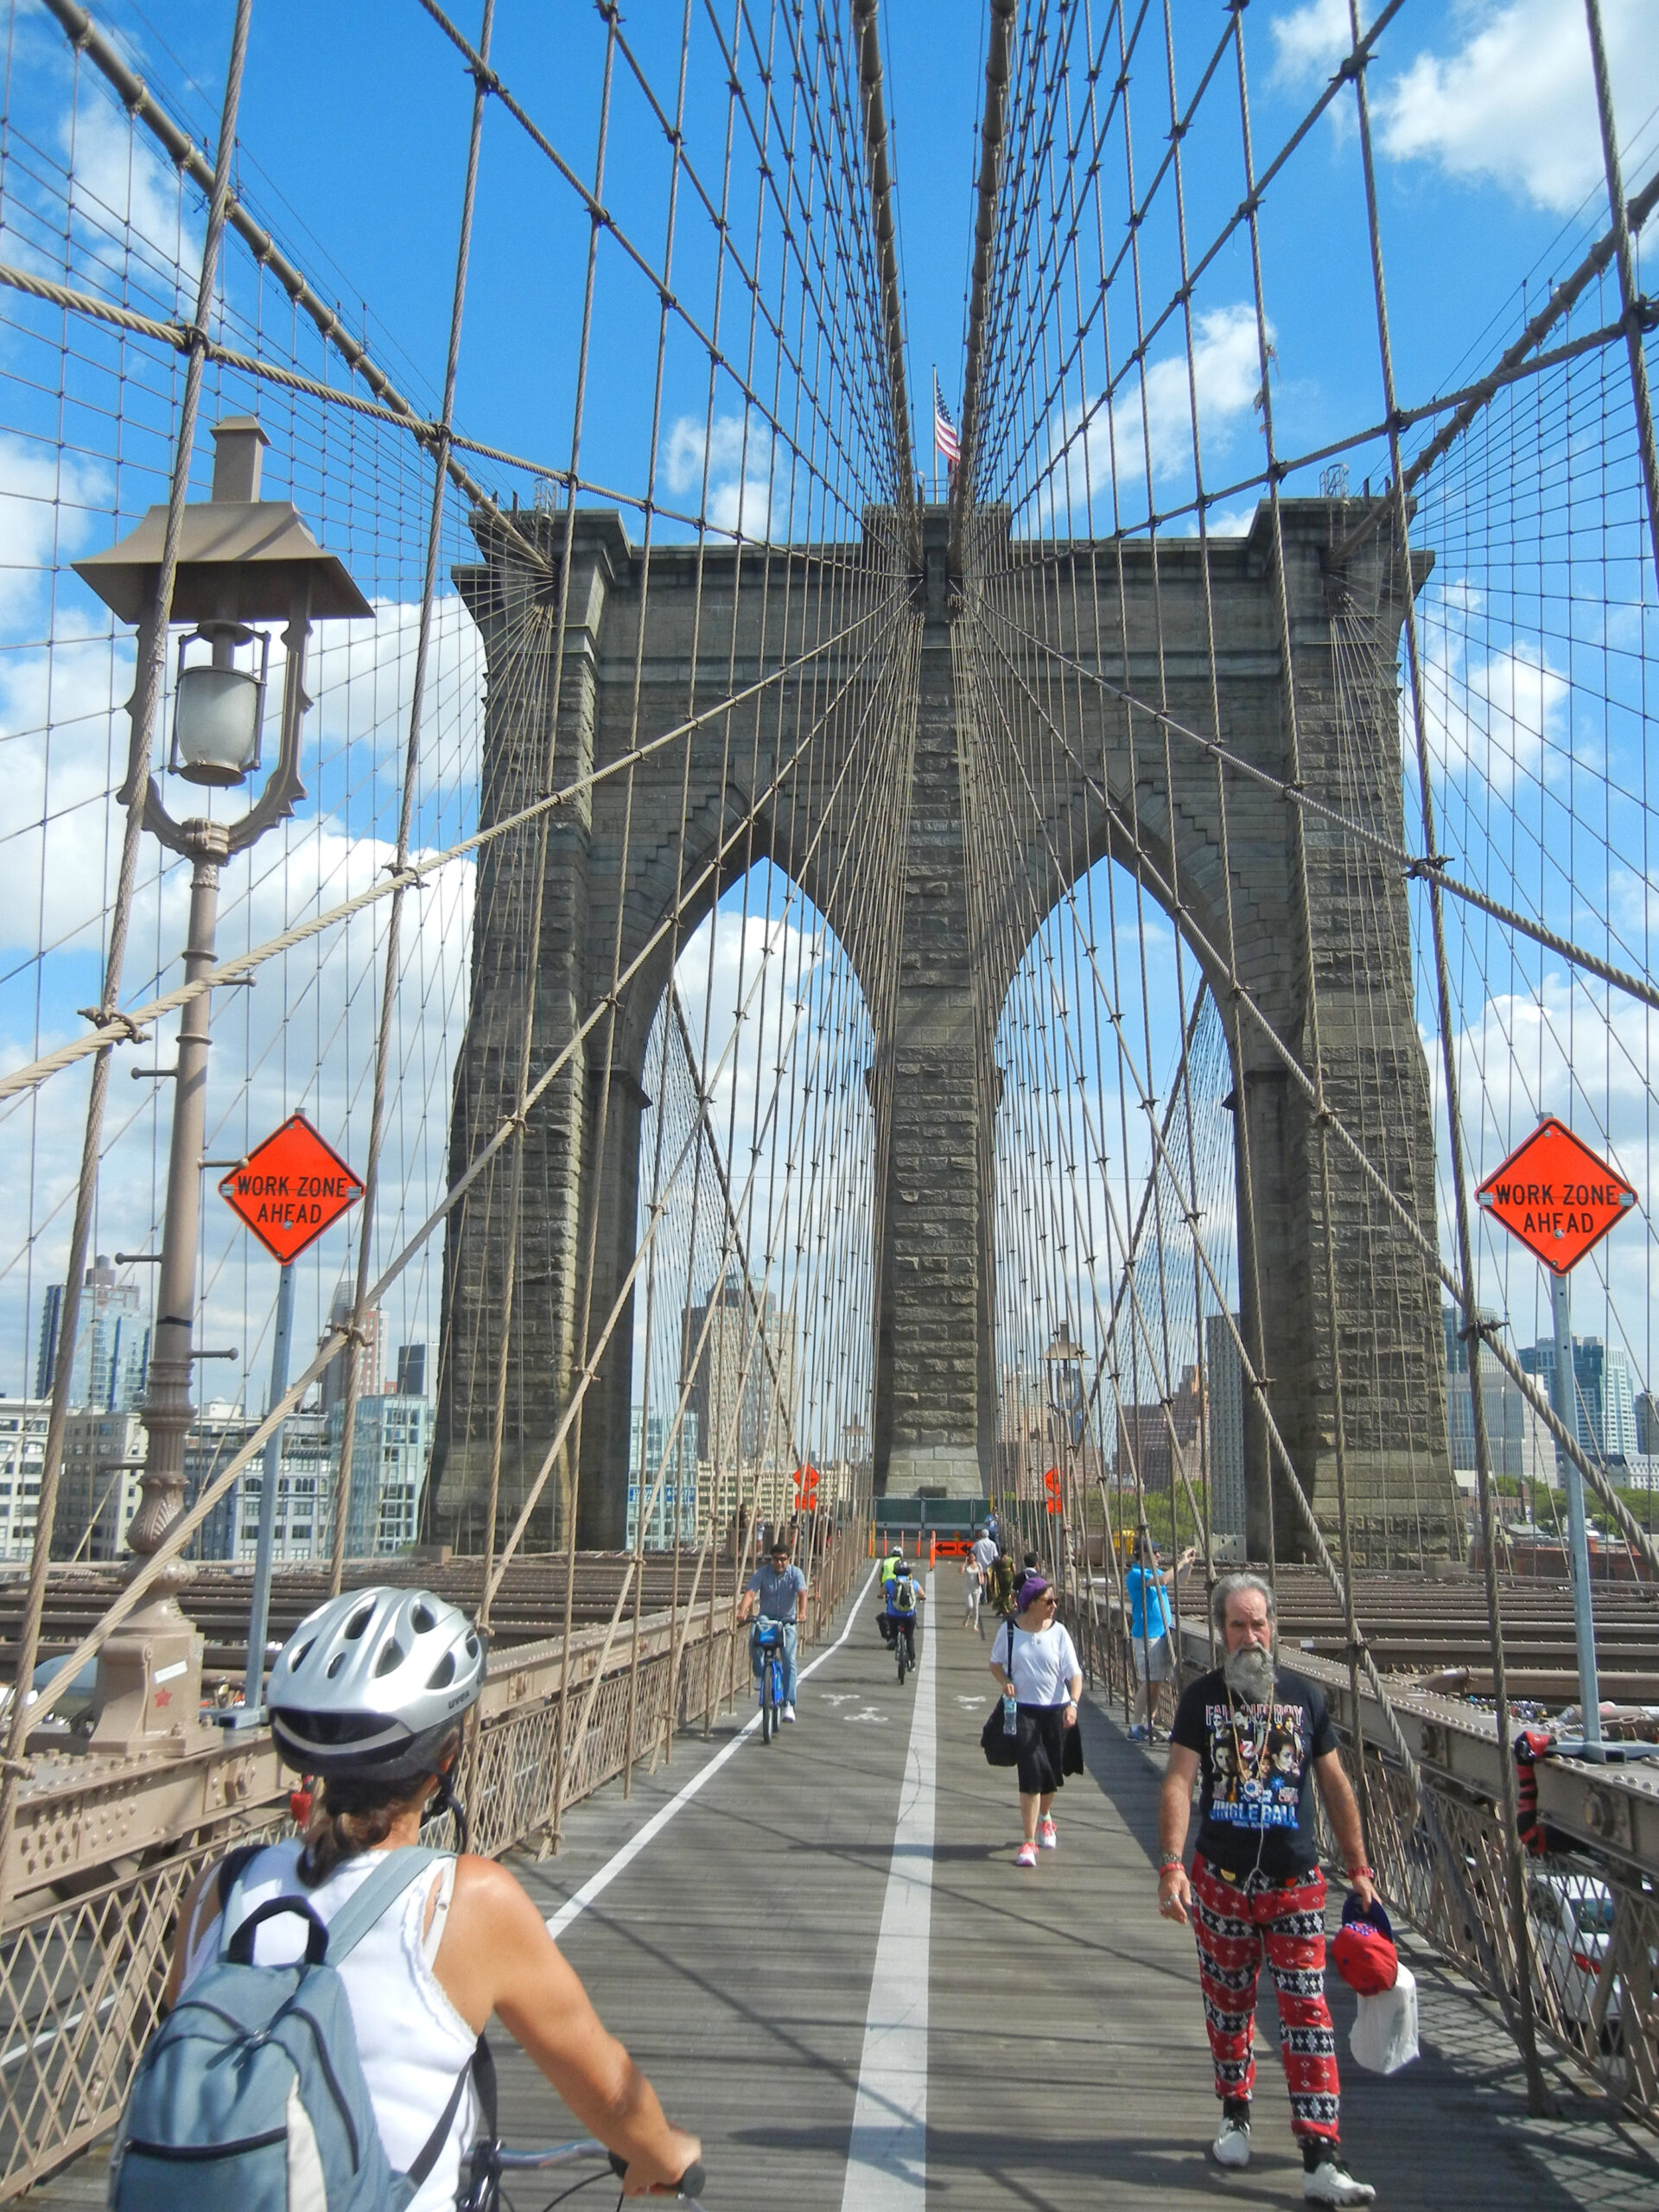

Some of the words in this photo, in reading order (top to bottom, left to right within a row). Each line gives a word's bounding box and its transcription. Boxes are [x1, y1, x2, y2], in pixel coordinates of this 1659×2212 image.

[238, 1175, 289, 1197] WORK
[296, 1177, 347, 1198] ZONE
[1496, 1184, 1554, 1206] WORK
[1562, 1185, 1618, 1206] ZONE
[257, 1203, 322, 1224] AHEAD
[1523, 1212, 1594, 1234] AHEAD
[1274, 1704, 1303, 1726] BOY
[1209, 1800, 1259, 1821] JINGLE
[1261, 1803, 1298, 1827] BALL
